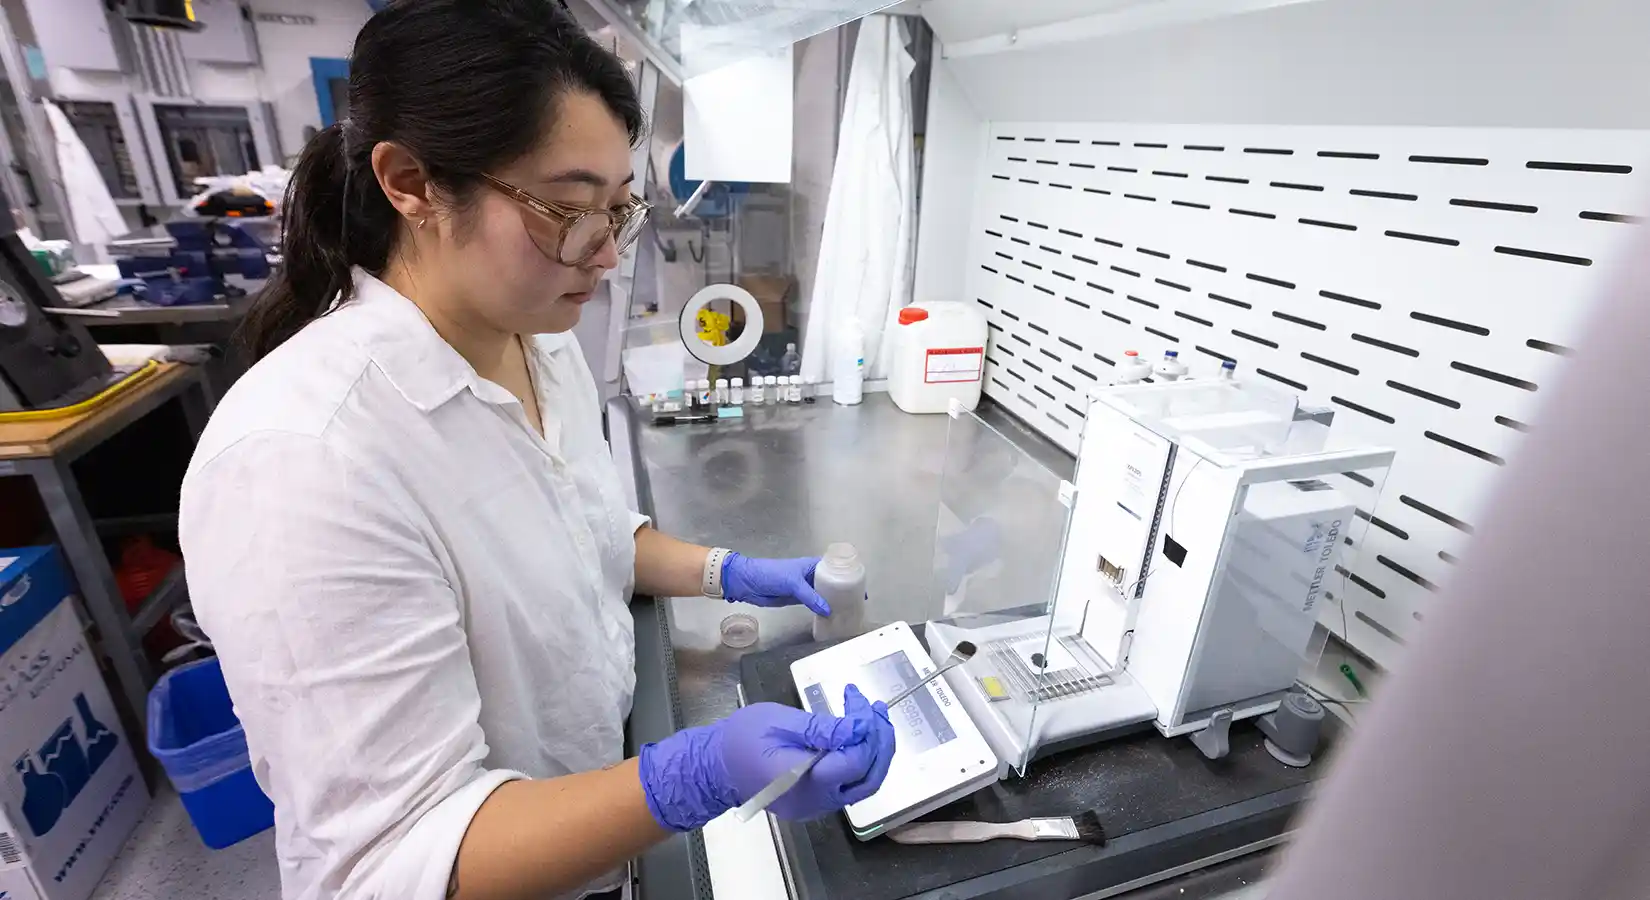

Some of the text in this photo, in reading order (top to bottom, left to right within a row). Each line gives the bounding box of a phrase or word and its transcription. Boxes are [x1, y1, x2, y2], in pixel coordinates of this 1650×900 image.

[1302, 519, 1341, 612] METTLER TOLEDO
[922, 666, 938, 688] MEER
[935, 687, 951, 707] TOLEDO
